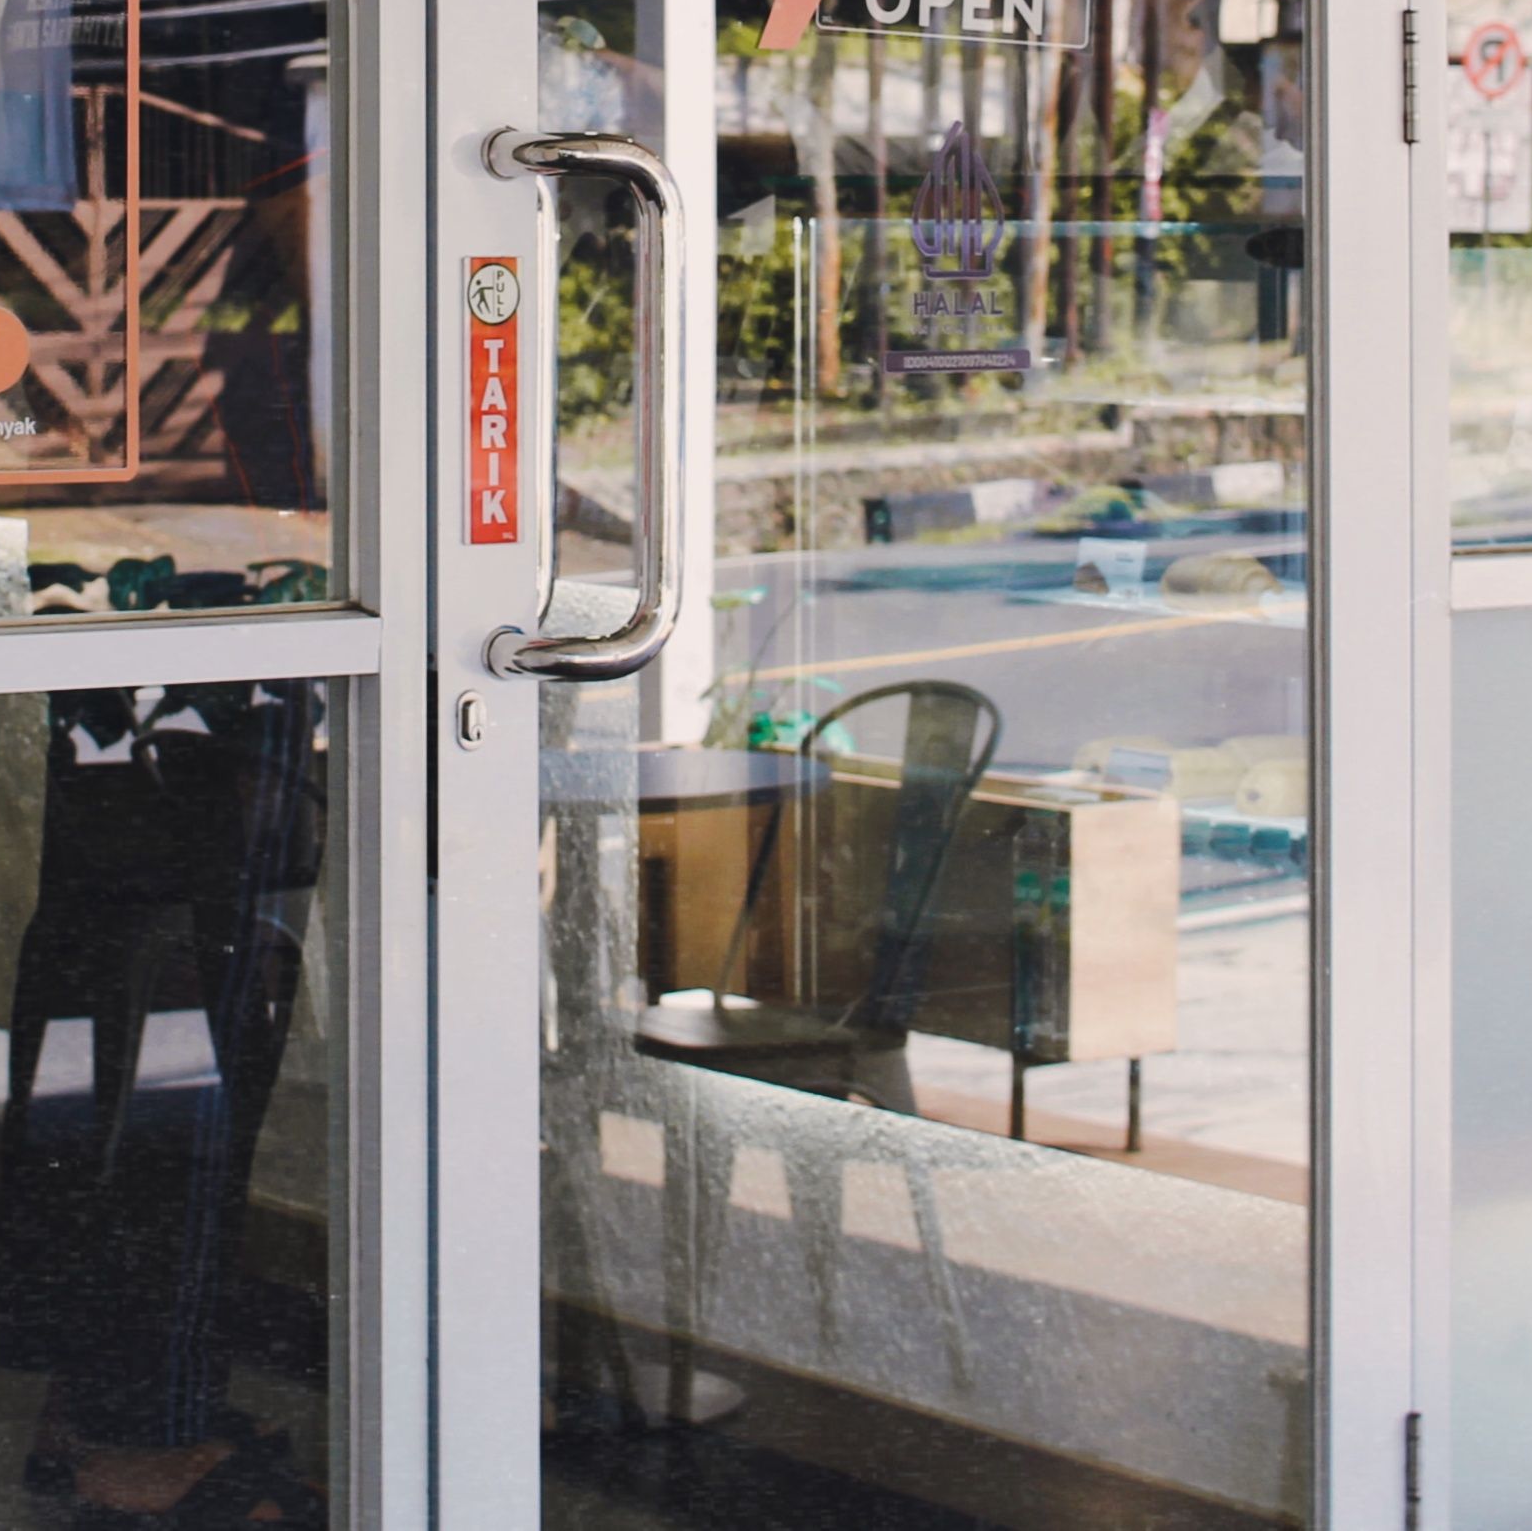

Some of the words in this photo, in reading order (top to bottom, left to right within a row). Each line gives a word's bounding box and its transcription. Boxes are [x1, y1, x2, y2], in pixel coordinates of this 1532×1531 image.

[495, 270, 505, 317] PULL
[913, 291, 1003, 316] HALAL
[480, 338, 508, 525] TARIK
